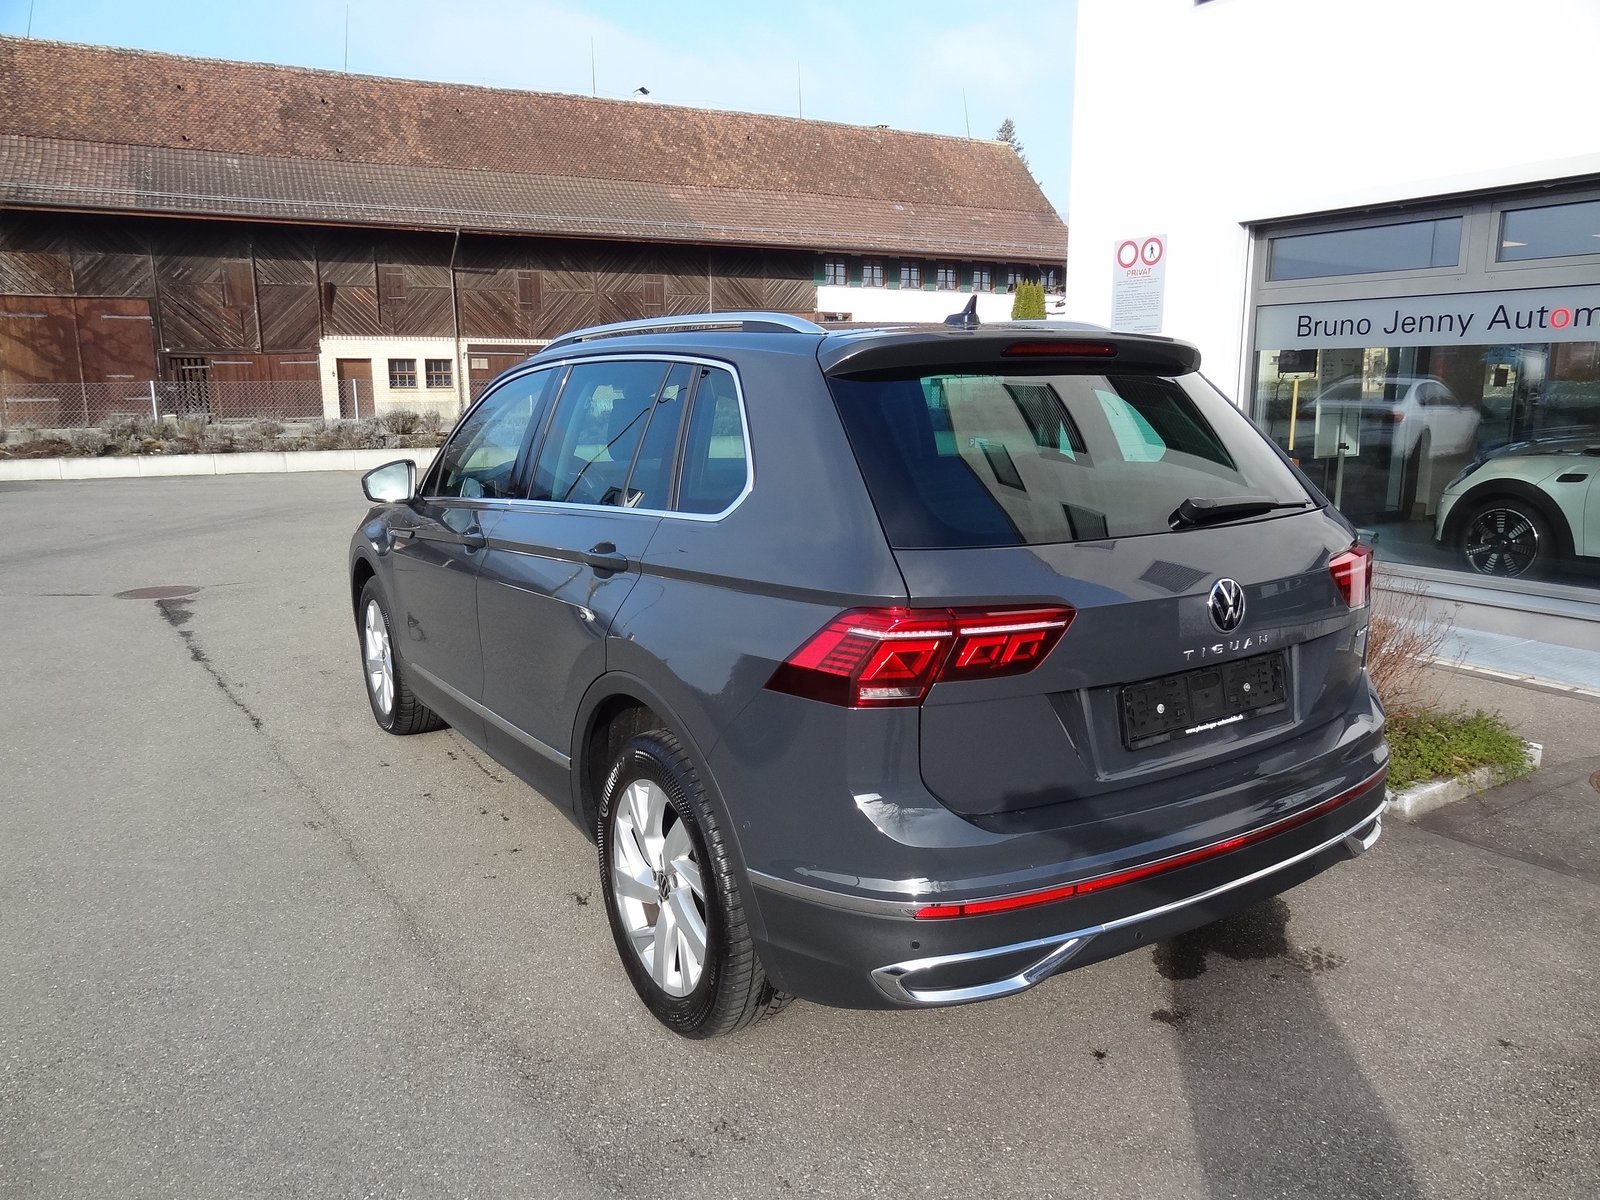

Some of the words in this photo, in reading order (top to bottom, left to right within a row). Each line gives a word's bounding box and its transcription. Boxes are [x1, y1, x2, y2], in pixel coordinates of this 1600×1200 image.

[1126, 267, 1152, 277] PRIVAT
[1297, 314, 1371, 337] Bruno
[1383, 310, 1475, 337] Jenny
[1486, 304, 1600, 330] Autom
[1183, 634, 1268, 661] TIGUAN
